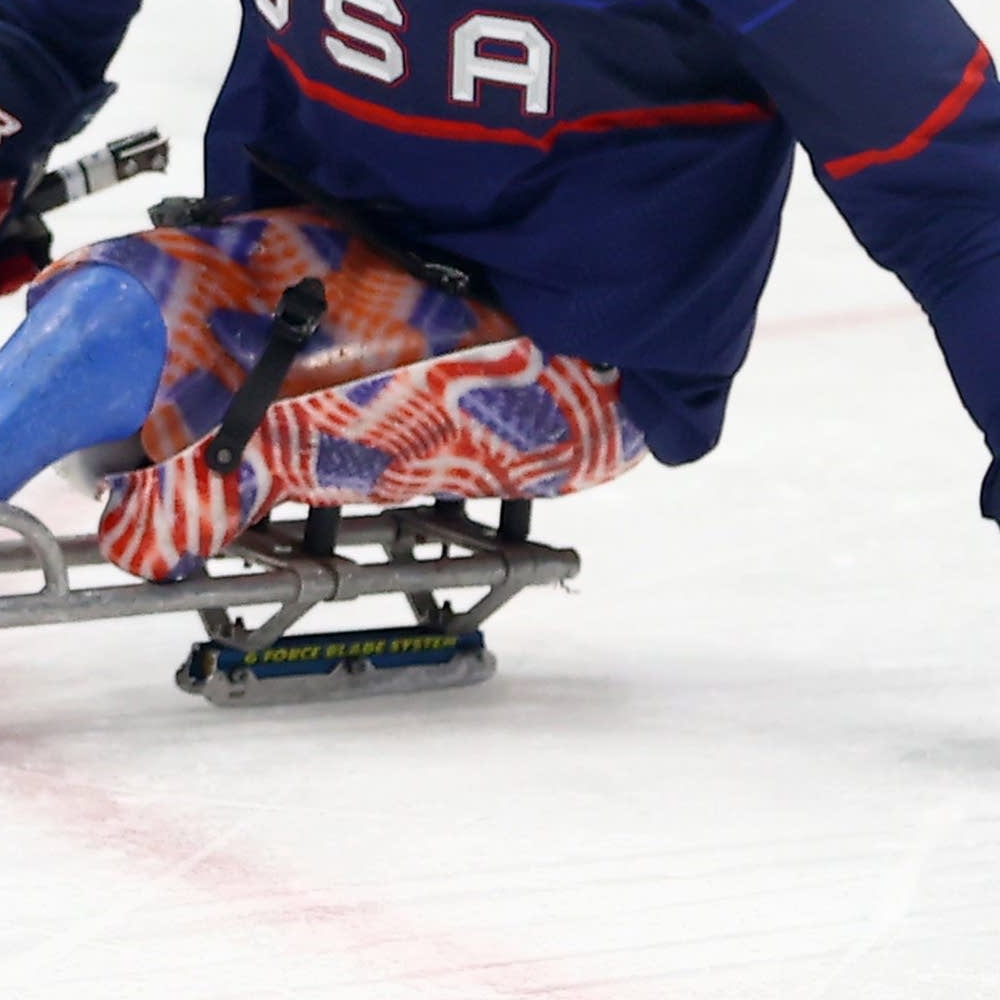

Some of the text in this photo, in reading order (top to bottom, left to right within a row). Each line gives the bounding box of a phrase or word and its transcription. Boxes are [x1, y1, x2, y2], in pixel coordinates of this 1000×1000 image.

[263, 645, 322, 663] FORCE
[326, 638, 387, 659] BLADE
[390, 635, 457, 653] SYSTEM
